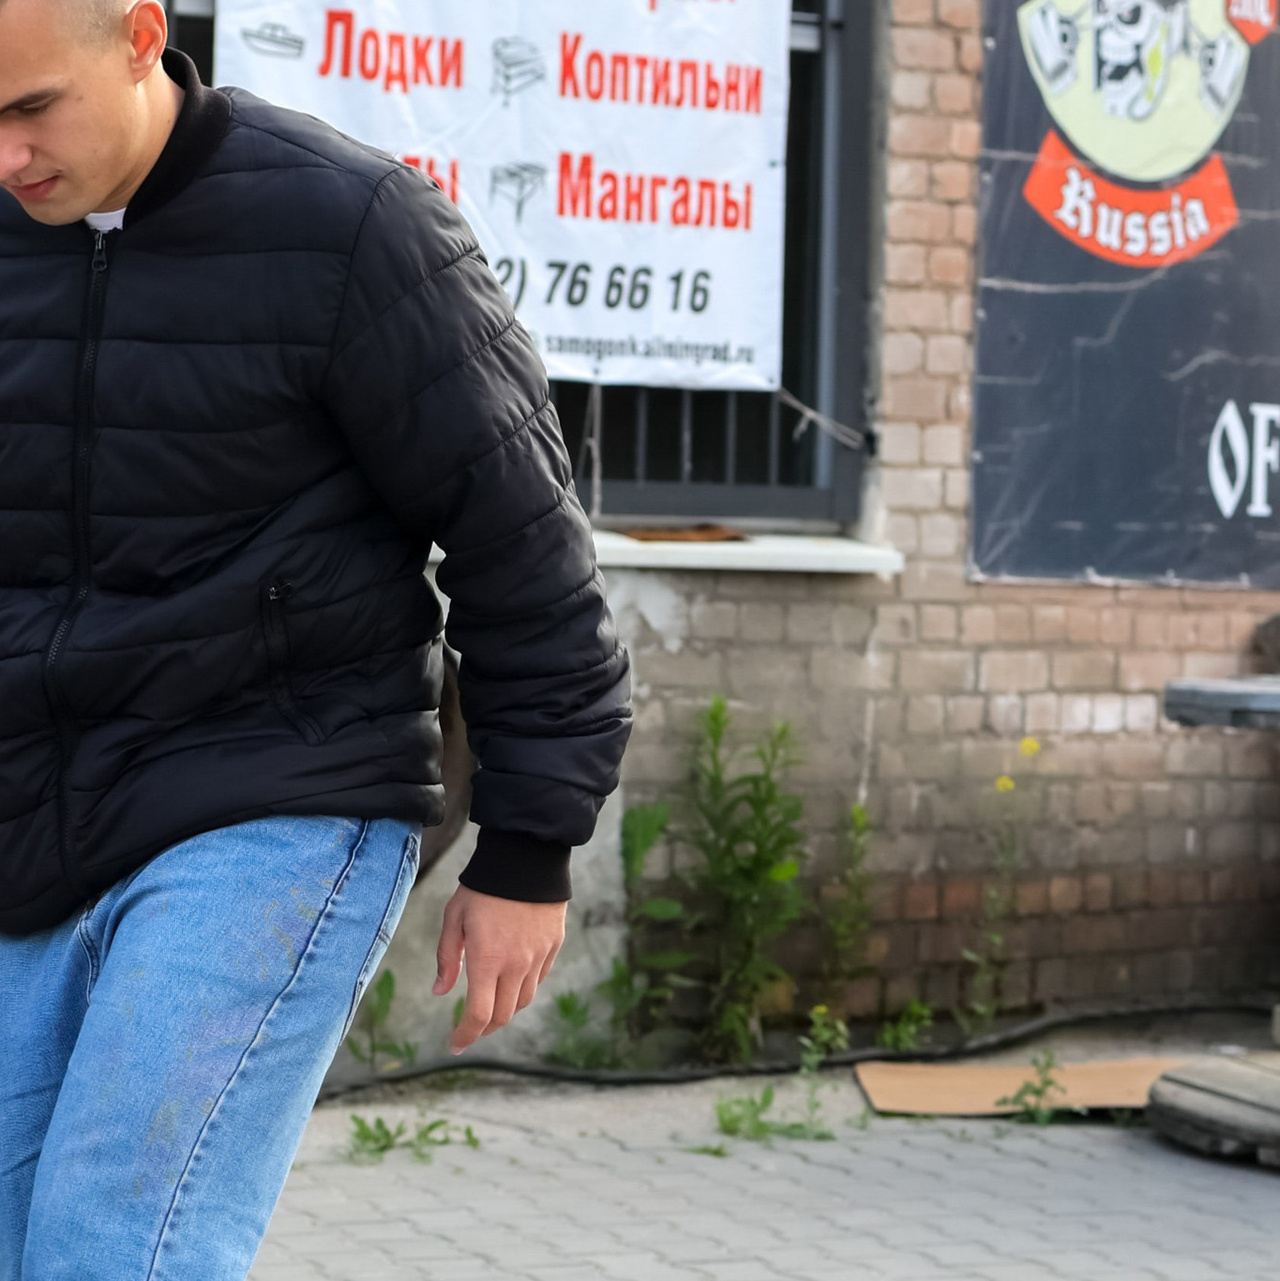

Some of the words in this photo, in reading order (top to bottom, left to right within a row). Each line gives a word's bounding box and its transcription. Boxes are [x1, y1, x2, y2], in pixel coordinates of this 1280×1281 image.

[318, 9, 464, 94] Лодки
[558, 32, 763, 115] Коптильни
[556, 151, 753, 231] Мангалы
[1053, 166, 1210, 257] Russia
[546, 260, 592, 307] 76
[604, 264, 653, 310] 66
[669, 269, 712, 313] 16
